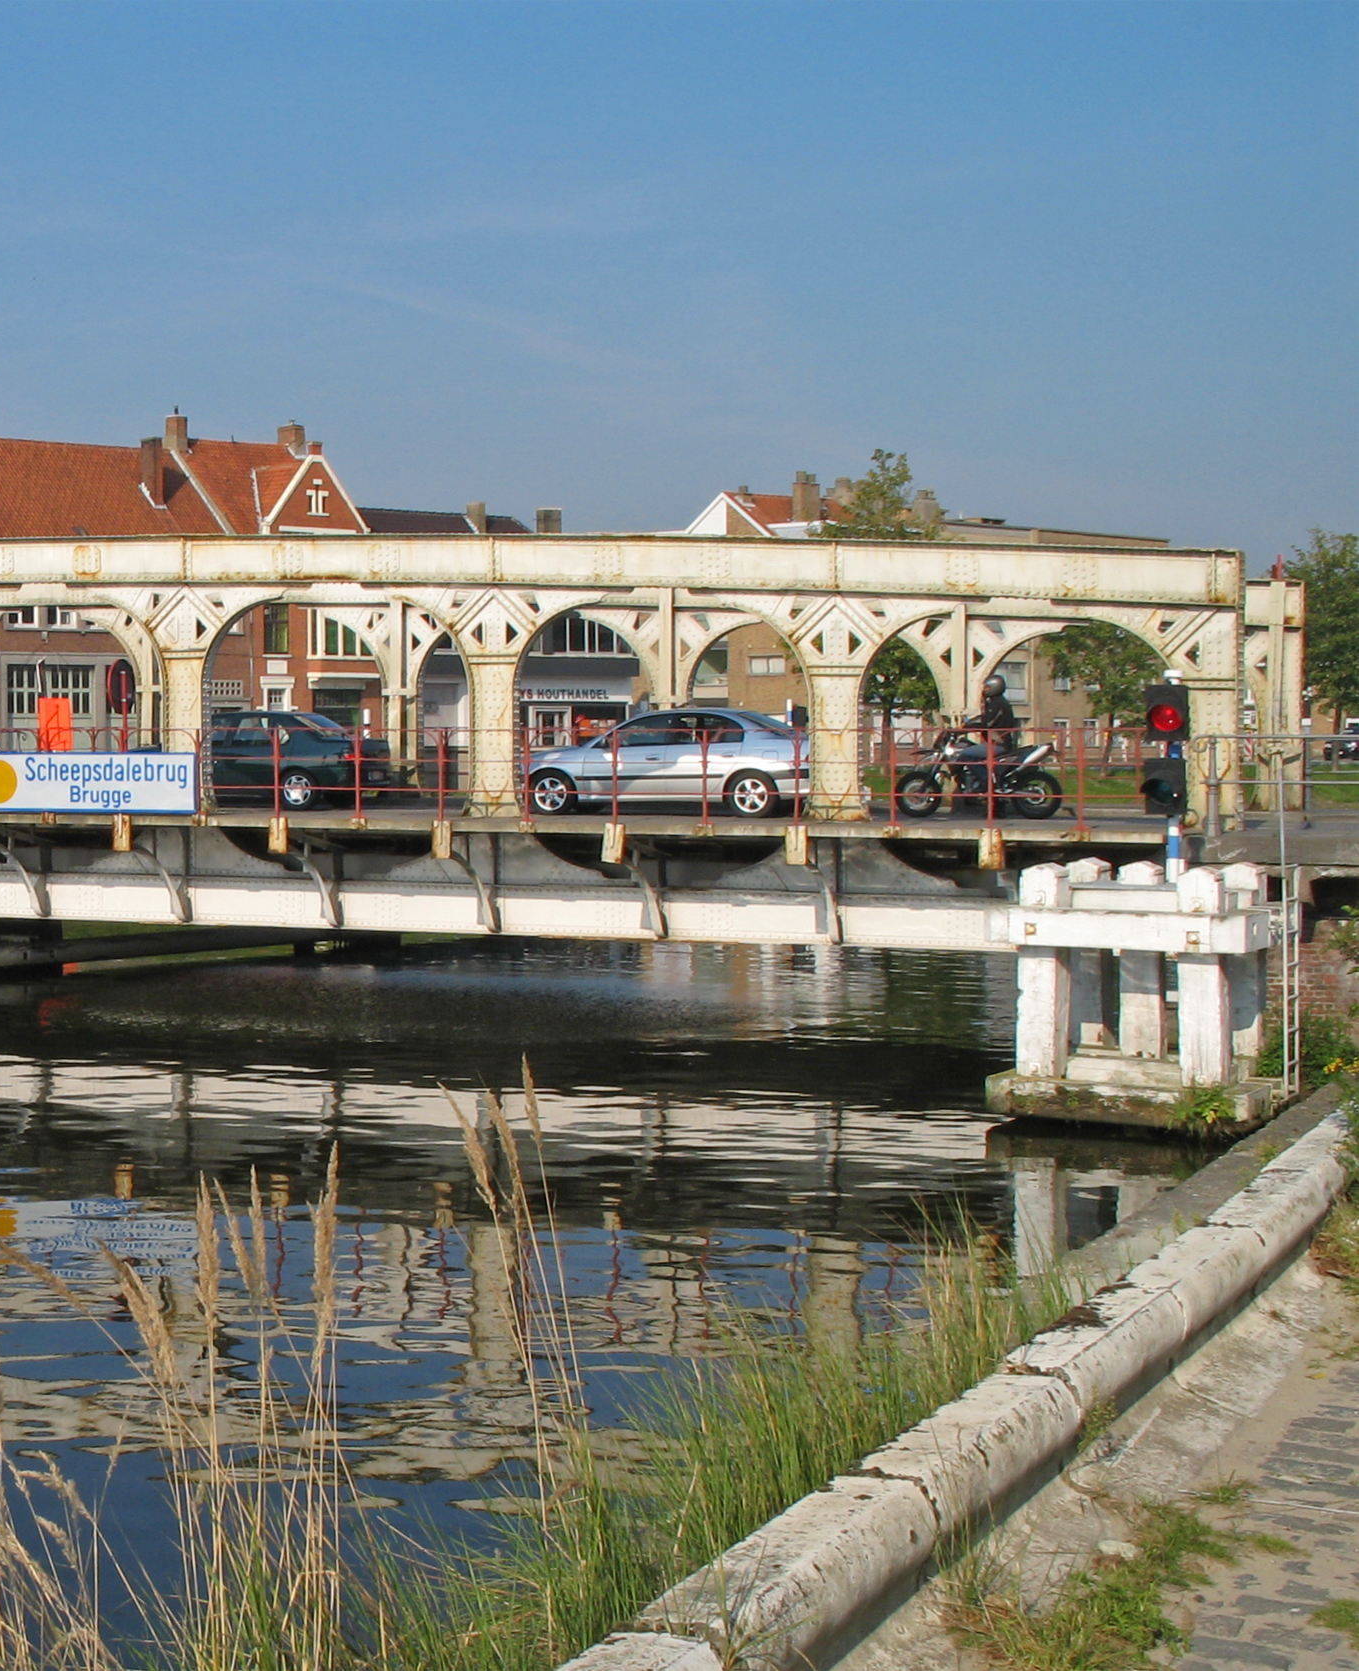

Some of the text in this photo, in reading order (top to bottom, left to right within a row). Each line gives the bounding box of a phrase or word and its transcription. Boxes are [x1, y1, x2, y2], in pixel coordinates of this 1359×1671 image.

[537, 688, 609, 700] HOUTHANDEL
[25, 757, 188, 788] Scheepsdalebrug
[70, 785, 132, 807] Brugge
